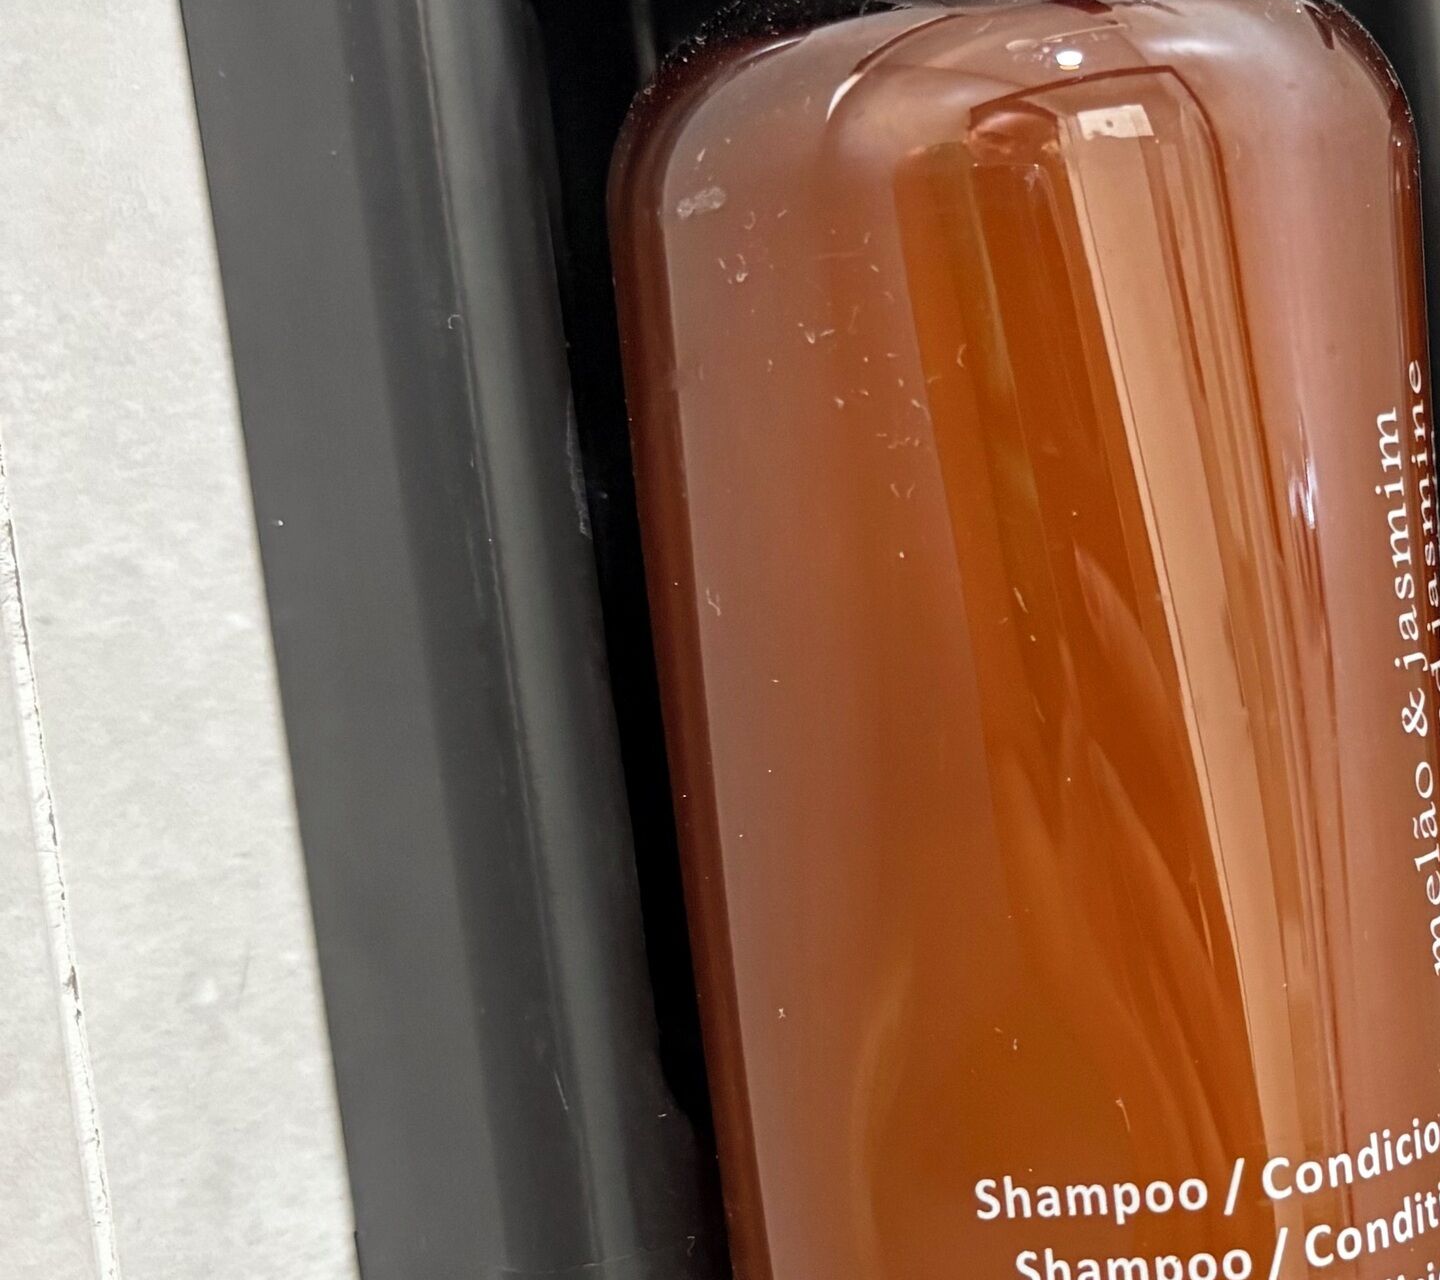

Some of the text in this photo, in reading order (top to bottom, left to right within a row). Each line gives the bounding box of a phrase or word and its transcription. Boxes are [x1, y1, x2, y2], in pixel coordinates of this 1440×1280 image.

[1374, 406, 1429, 672] jasmim
[1401, 687, 1429, 738] &
[973, 1175, 1210, 1225] Shampoo
[1222, 1156, 1246, 1217] /
